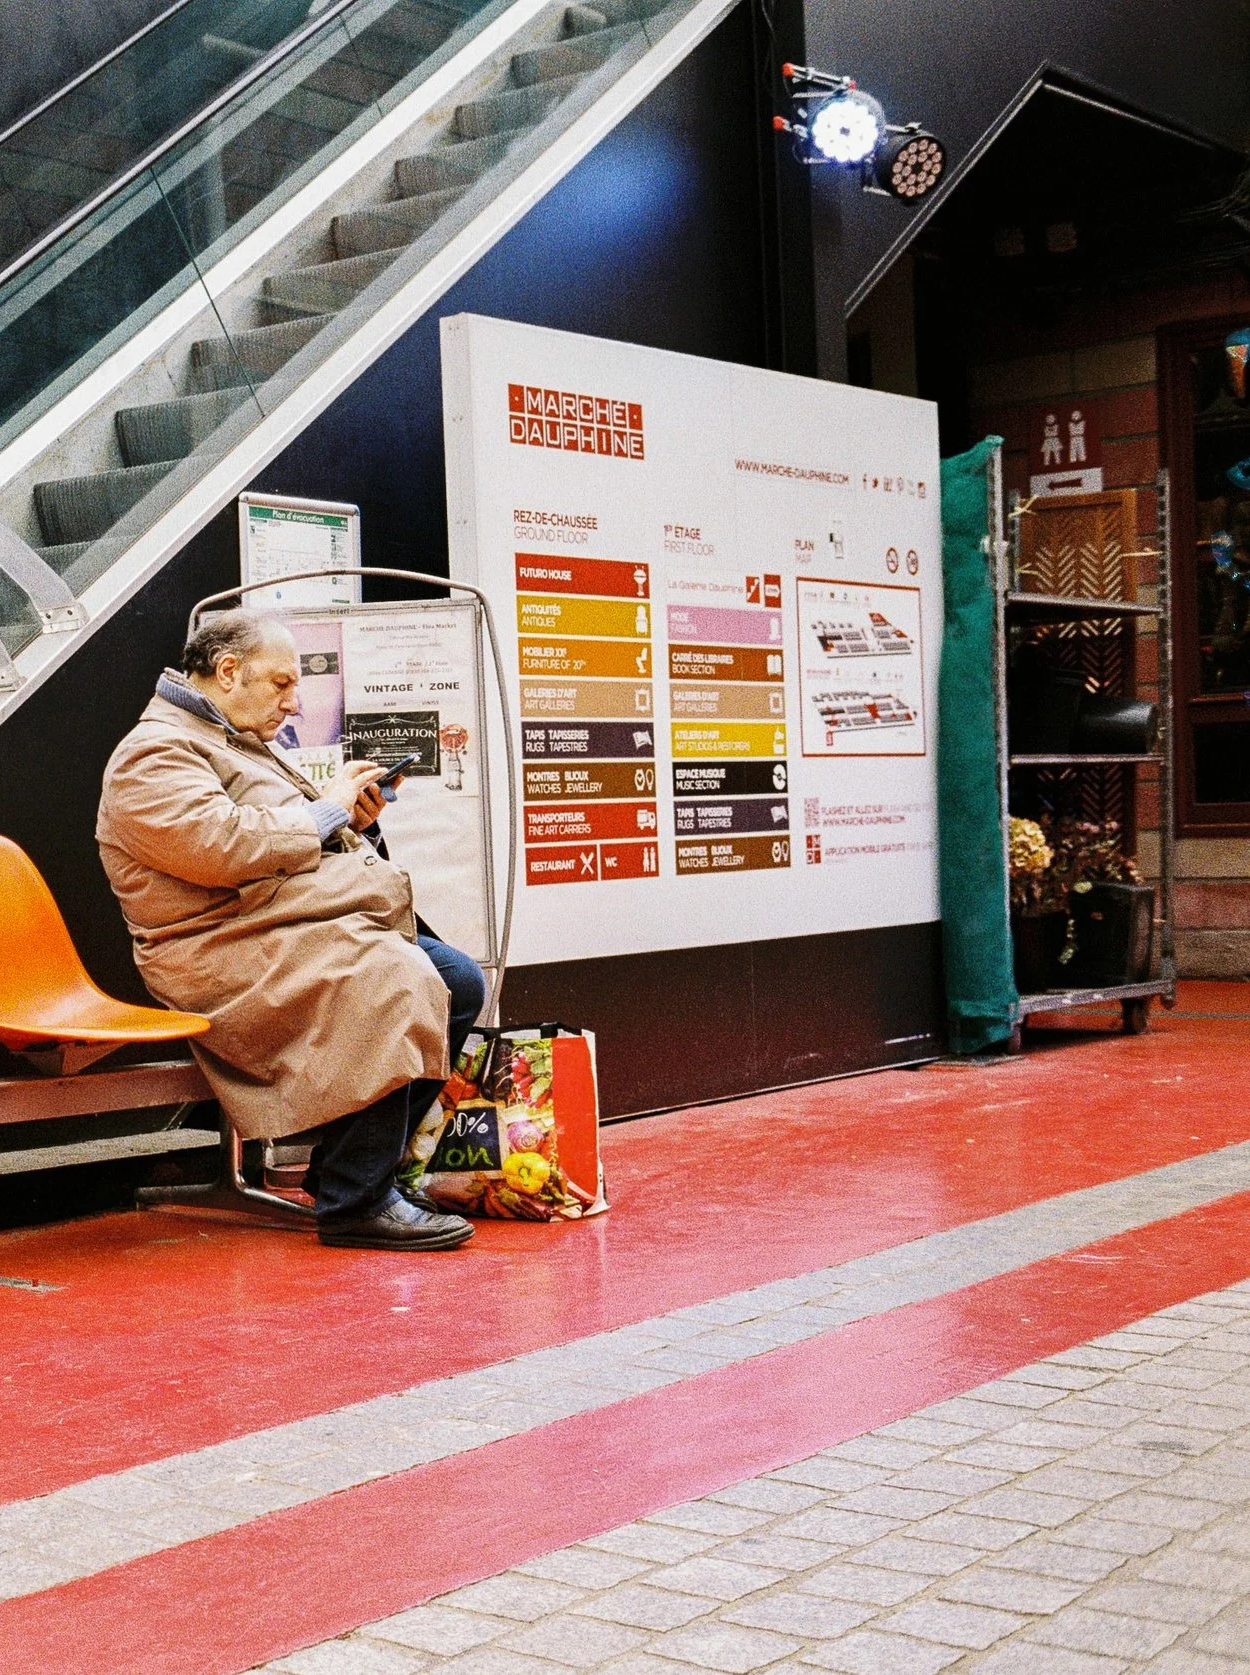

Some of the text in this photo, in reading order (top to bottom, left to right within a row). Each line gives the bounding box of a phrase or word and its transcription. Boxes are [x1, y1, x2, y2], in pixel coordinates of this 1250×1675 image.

[526, 390, 626, 425] MARCHÉ
[510, 418, 643, 456] DAUPHINE
[272, 510, 286, 519] Plan
[513, 509, 598, 530] REZ-DE-CHAUSSÉE
[514, 525, 589, 544] GROUND FLOOR
[664, 540, 714, 556] FIRST FLOOR
[519, 567, 572, 581] FUTURO HOUSE
[522, 616, 556, 627] ANTIQUES
[364, 684, 414, 693] VINTAGE
[429, 682, 460, 690] ZONE
[349, 728, 438, 742] INAUGURATION
[525, 730, 590, 740] TAPIS TAPISSERIES
[526, 742, 588, 752] RUGS TAPESTRIES
[527, 771, 589, 782] MONTRES BIJOUX
[527, 782, 603, 794] WATCHES JEWELLERY
[527, 811, 586, 824] TRANSPORTEURS
[528, 823, 592, 836] FINE ART CARRIERS
[530, 859, 576, 872] RESTAURANT
[605, 856, 618, 867] WC
